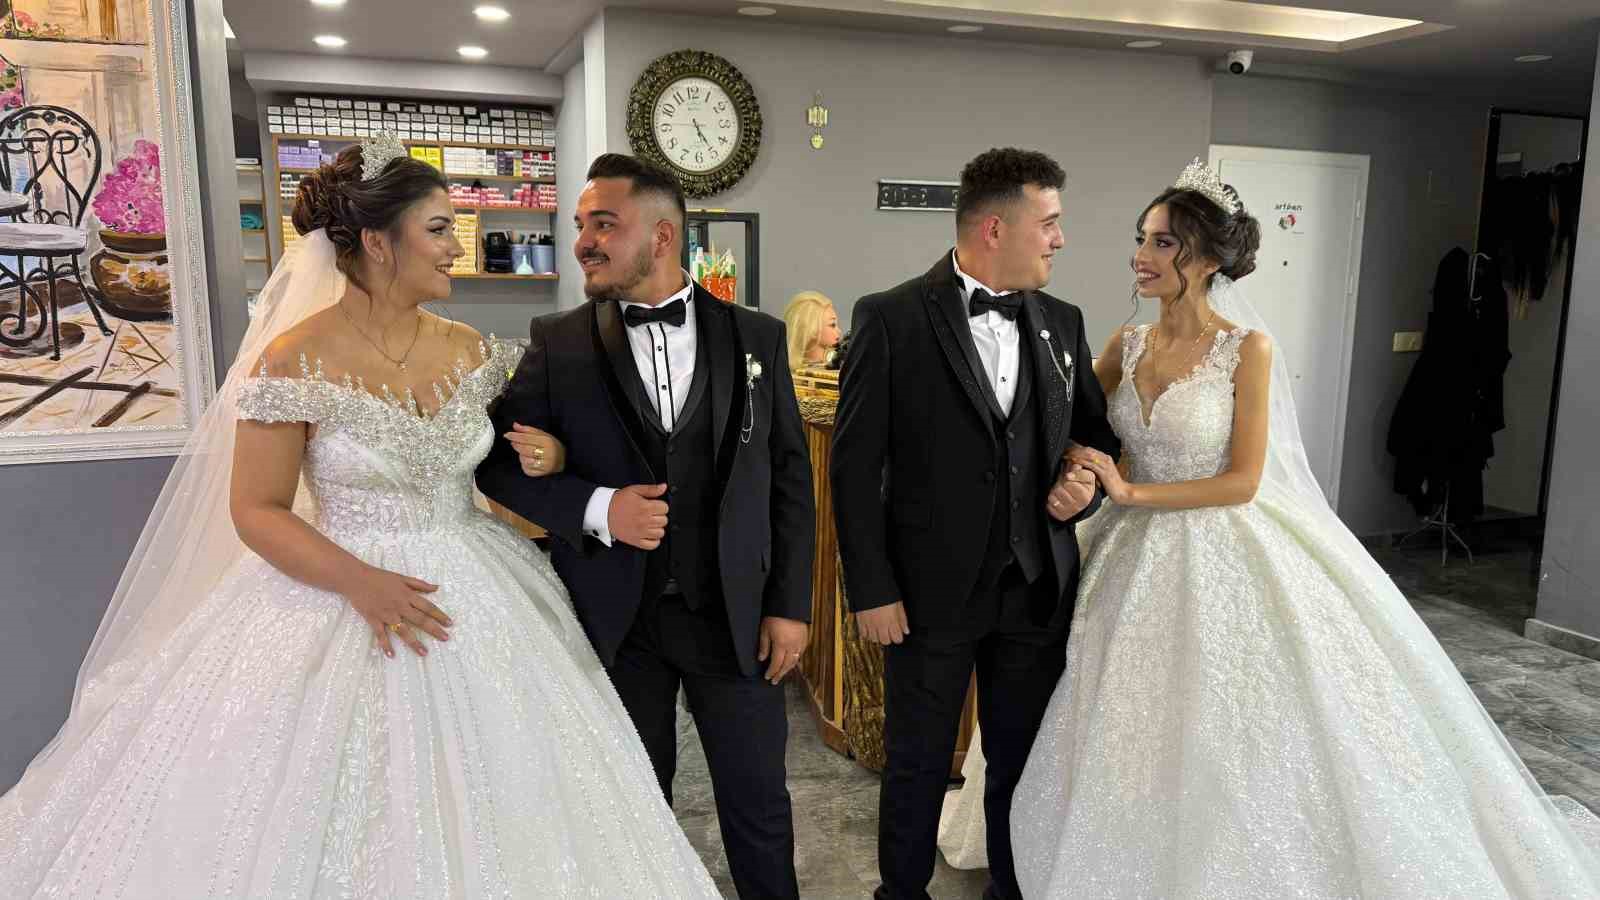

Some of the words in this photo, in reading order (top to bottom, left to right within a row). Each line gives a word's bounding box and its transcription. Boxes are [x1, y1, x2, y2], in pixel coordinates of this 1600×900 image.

[673, 92, 685, 105] 11
[687, 86, 699, 101] 12
[705, 91, 711, 102] 1
[662, 103, 675, 117] 10
[713, 101, 726, 113] 2
[661, 123, 672, 132] 9
[719, 119, 730, 128] 3
[668, 137, 678, 149] 8
[718, 136, 728, 144] 4
[680, 148, 690, 160] 7
[695, 152, 703, 163] 6
[708, 146, 718, 159] 5
